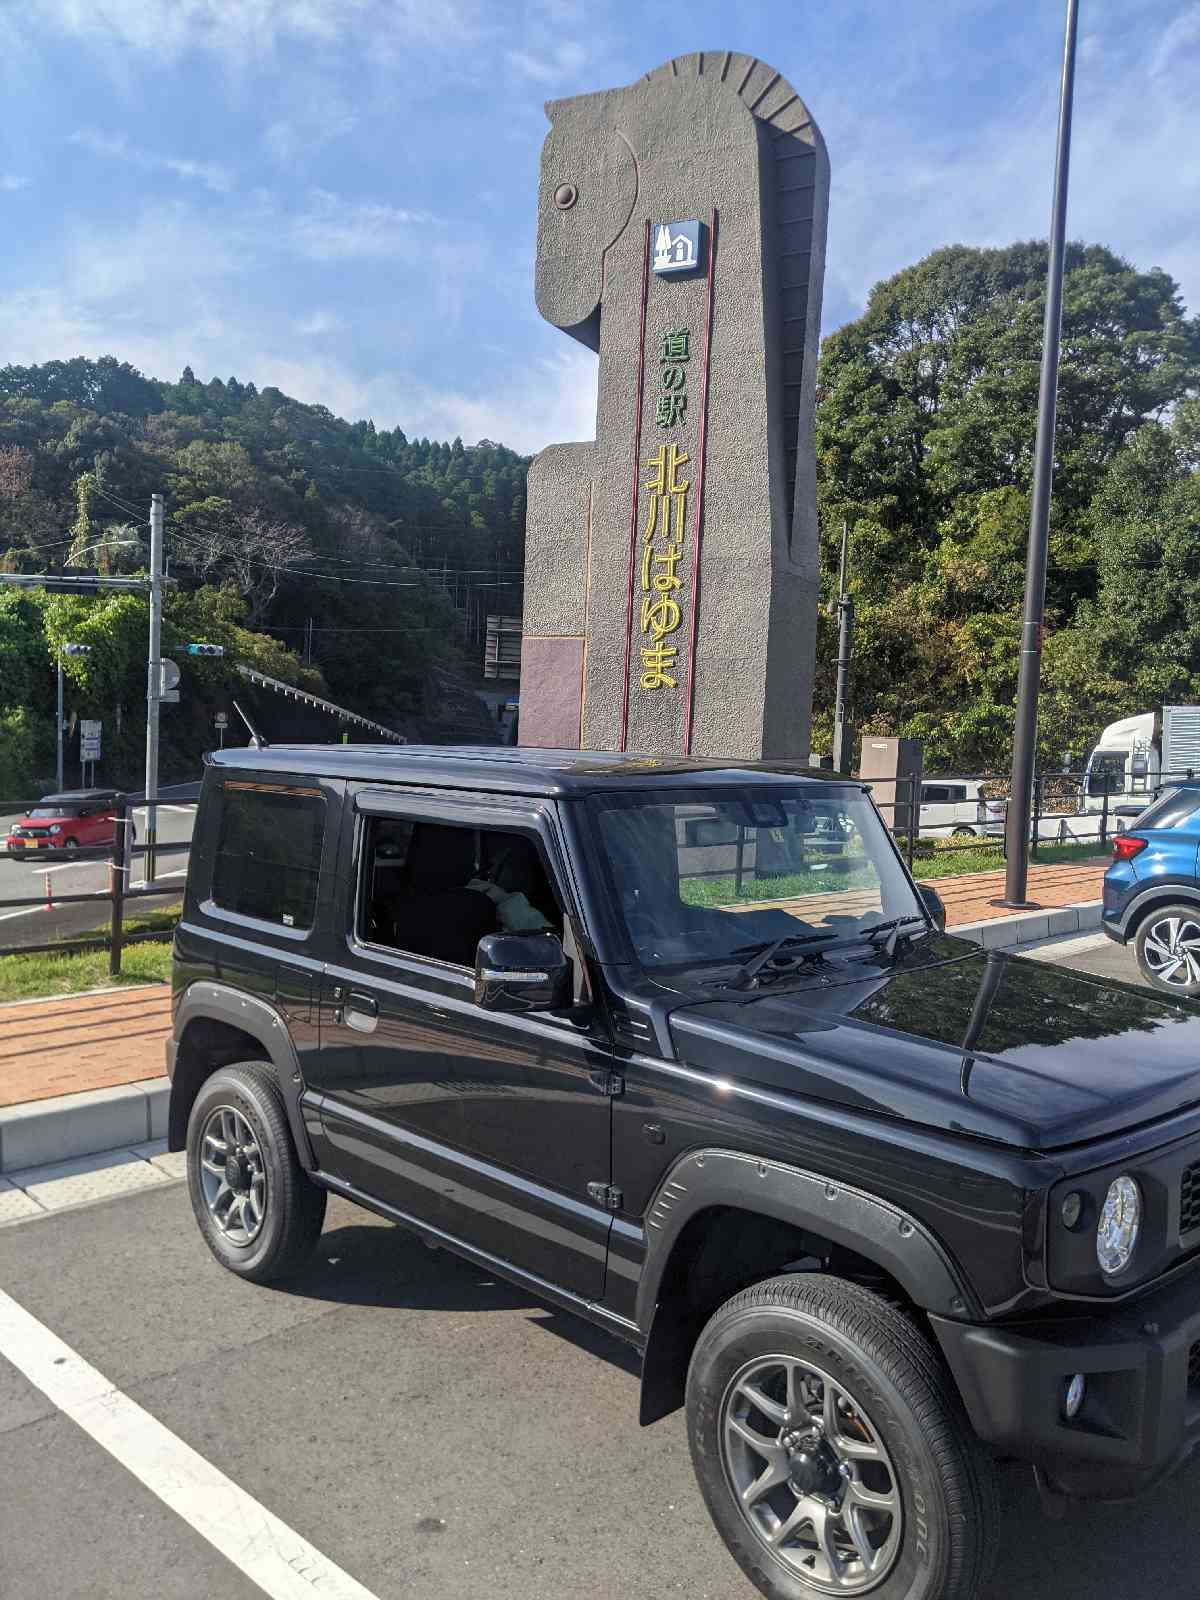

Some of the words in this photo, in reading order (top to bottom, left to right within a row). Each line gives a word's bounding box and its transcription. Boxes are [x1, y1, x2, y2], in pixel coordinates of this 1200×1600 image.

[655, 327, 690, 428] 道の駅
[640, 443, 689, 689] 北川はゆま
